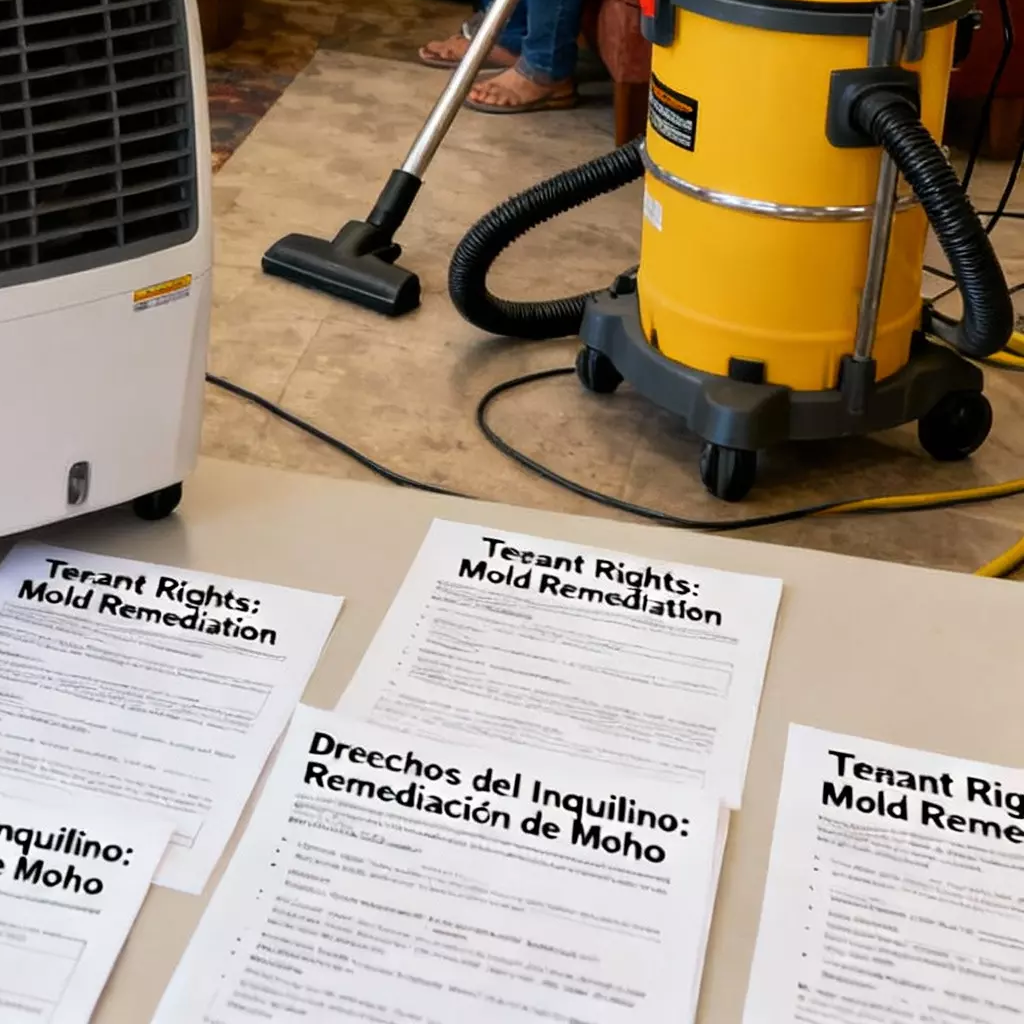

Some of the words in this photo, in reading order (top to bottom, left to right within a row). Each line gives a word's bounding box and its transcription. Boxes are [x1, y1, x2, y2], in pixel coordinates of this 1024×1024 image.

[458, 558, 533, 590] Mold
[594, 558, 701, 597] Rights:
[17, 579, 95, 611] Mold
[97, 593, 278, 647] Remediation
[307, 731, 462, 787] Dreechos
[471, 768, 522, 799] del
[531, 780, 690, 838] Inquilino:
[821, 781, 909, 822] Mold
[303, 761, 511, 831] Remediación
[520, 810, 562, 841] de
[570, 819, 667, 865] Moho
[13, 856, 105, 896] Moho
